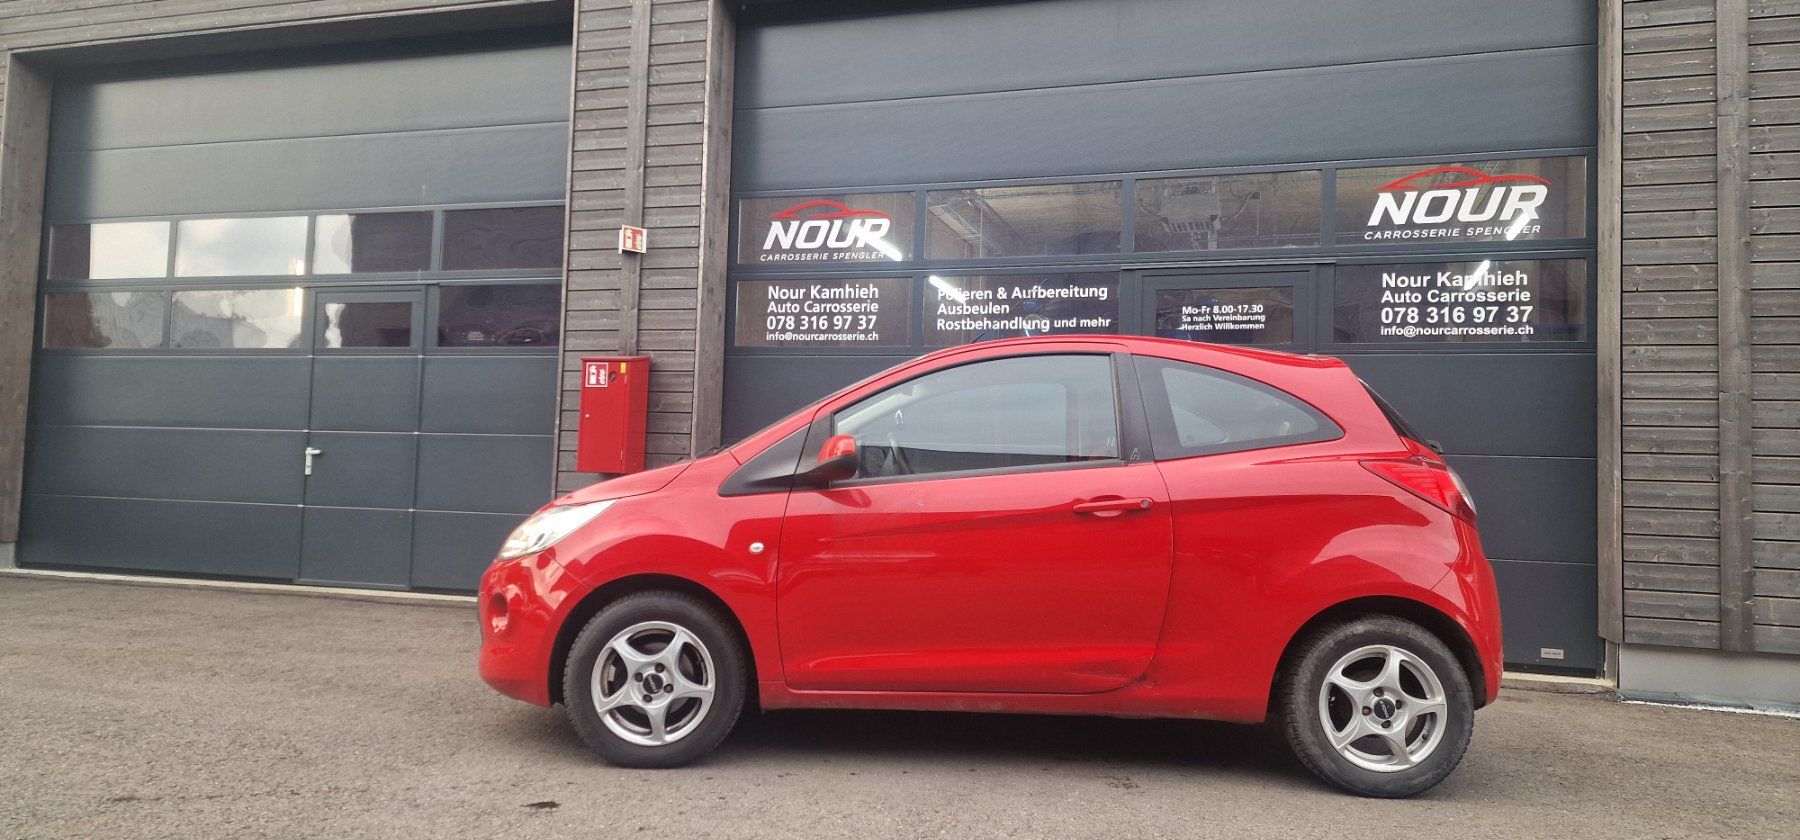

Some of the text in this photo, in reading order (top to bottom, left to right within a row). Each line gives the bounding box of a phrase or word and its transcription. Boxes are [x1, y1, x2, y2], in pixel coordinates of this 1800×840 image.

[1367, 185, 1548, 226] NOUR
[763, 218, 891, 250] NOUR
[1364, 225, 1541, 240] CARROSSERIE SPENER
[760, 251, 885, 262] CARROSSERIE SPENGLER
[1382, 273, 1431, 288] Nour
[768, 284, 879, 300] Nour Kamhieh
[937, 286, 1108, 300] Poeren & Aufbereitung
[1381, 289, 1531, 304] Auto Carrosserie
[767, 301, 879, 313] Auto Carrosserie
[937, 303, 1010, 315] Ausbeulen
[1182, 305, 1264, 315] Mo-Fr 8.00-17.30
[1213, 314, 1266, 323] Vereinbarung
[1381, 305, 1534, 324] 078 316 97 37
[766, 315, 877, 330] 078 316 97 37
[937, 317, 1111, 332] Rostbehandlung und mehr
[1182, 323, 1265, 331] Herzlich Willkommen
[766, 332, 879, 341] info@nourcarrosserie.ch
[1380, 324, 1534, 337] info@nourcarrosserie.ch
